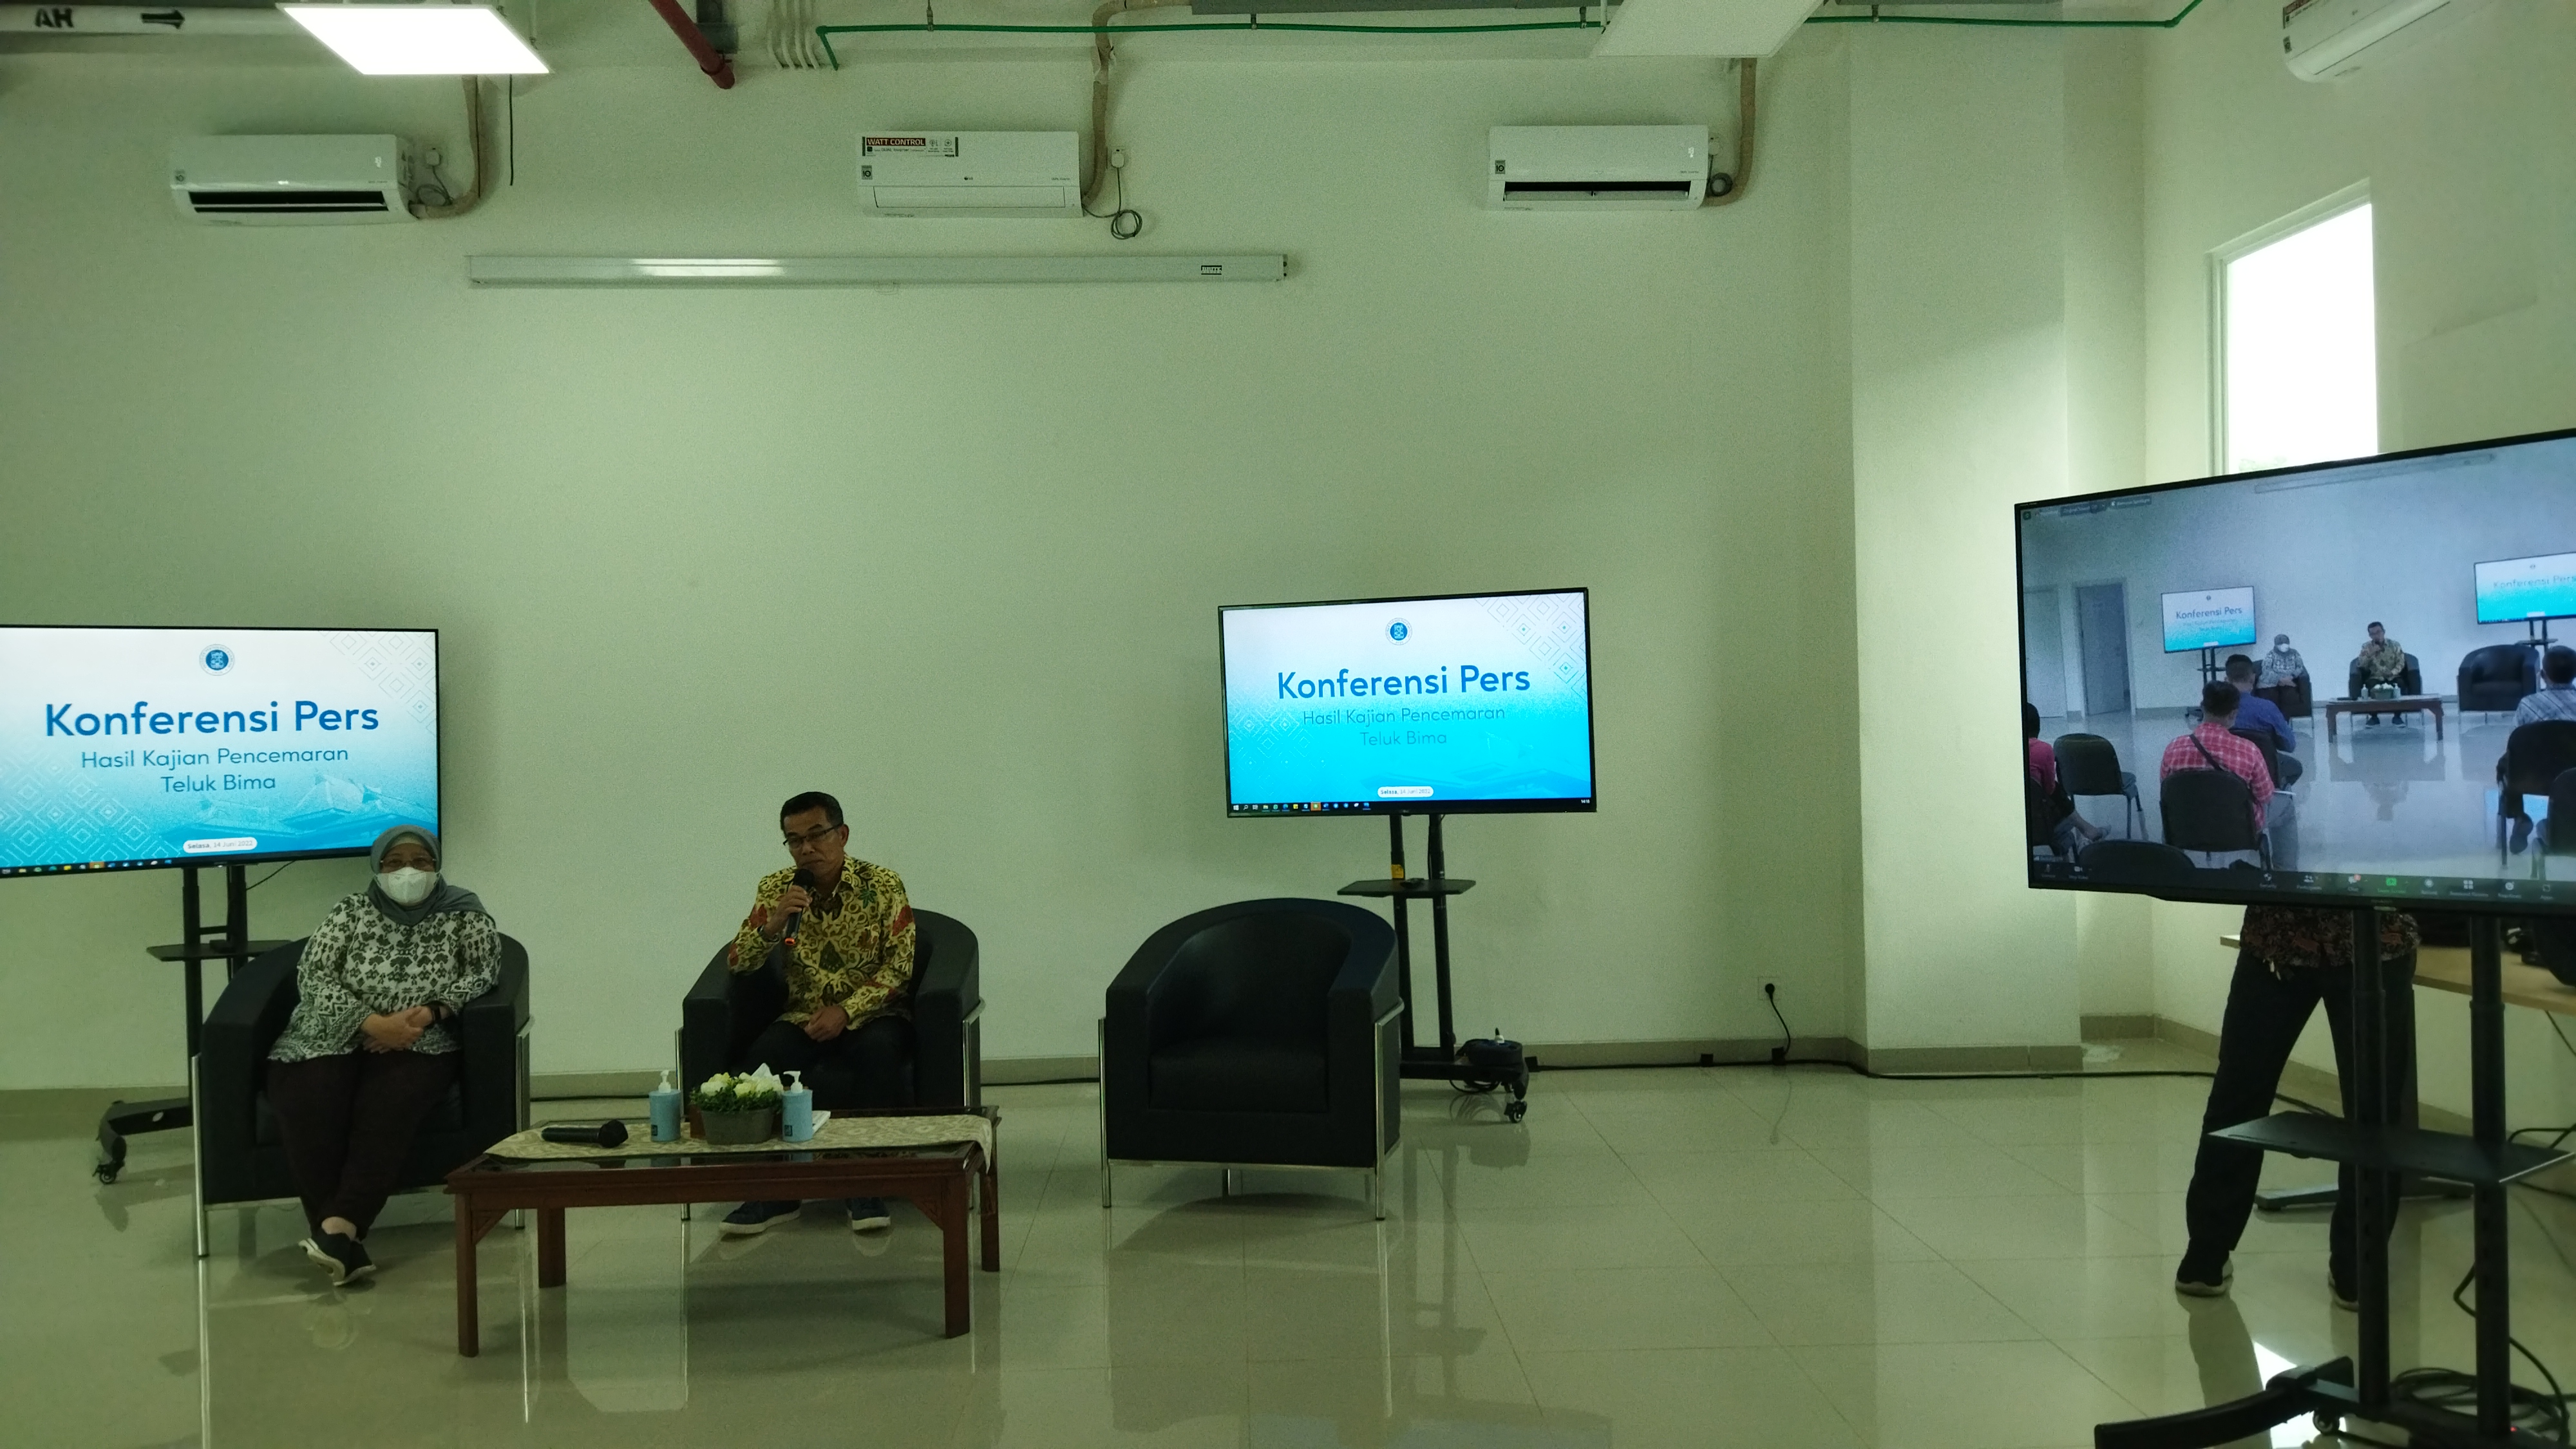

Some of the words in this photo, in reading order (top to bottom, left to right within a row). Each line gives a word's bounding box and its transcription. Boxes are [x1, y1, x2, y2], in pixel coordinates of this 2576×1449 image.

[2176, 609, 2221, 619] Konferensi
[1278, 667, 1448, 699] Konferensi
[1461, 665, 1530, 693] Pers
[45, 701, 279, 737] Konferensi
[295, 700, 379, 731] Pers
[1303, 710, 1341, 725] Hasil
[1347, 709, 1396, 728] Kajian
[1401, 707, 1505, 723] Pencemaran
[1359, 732, 1401, 746] Teluk
[1407, 730, 1447, 744] Bima
[82, 752, 135, 768] Hasil
[144, 750, 210, 771] Kajian
[217, 747, 348, 764] Pencemaran
[160, 775, 217, 792] Teluk
[223, 774, 276, 790] Bima
